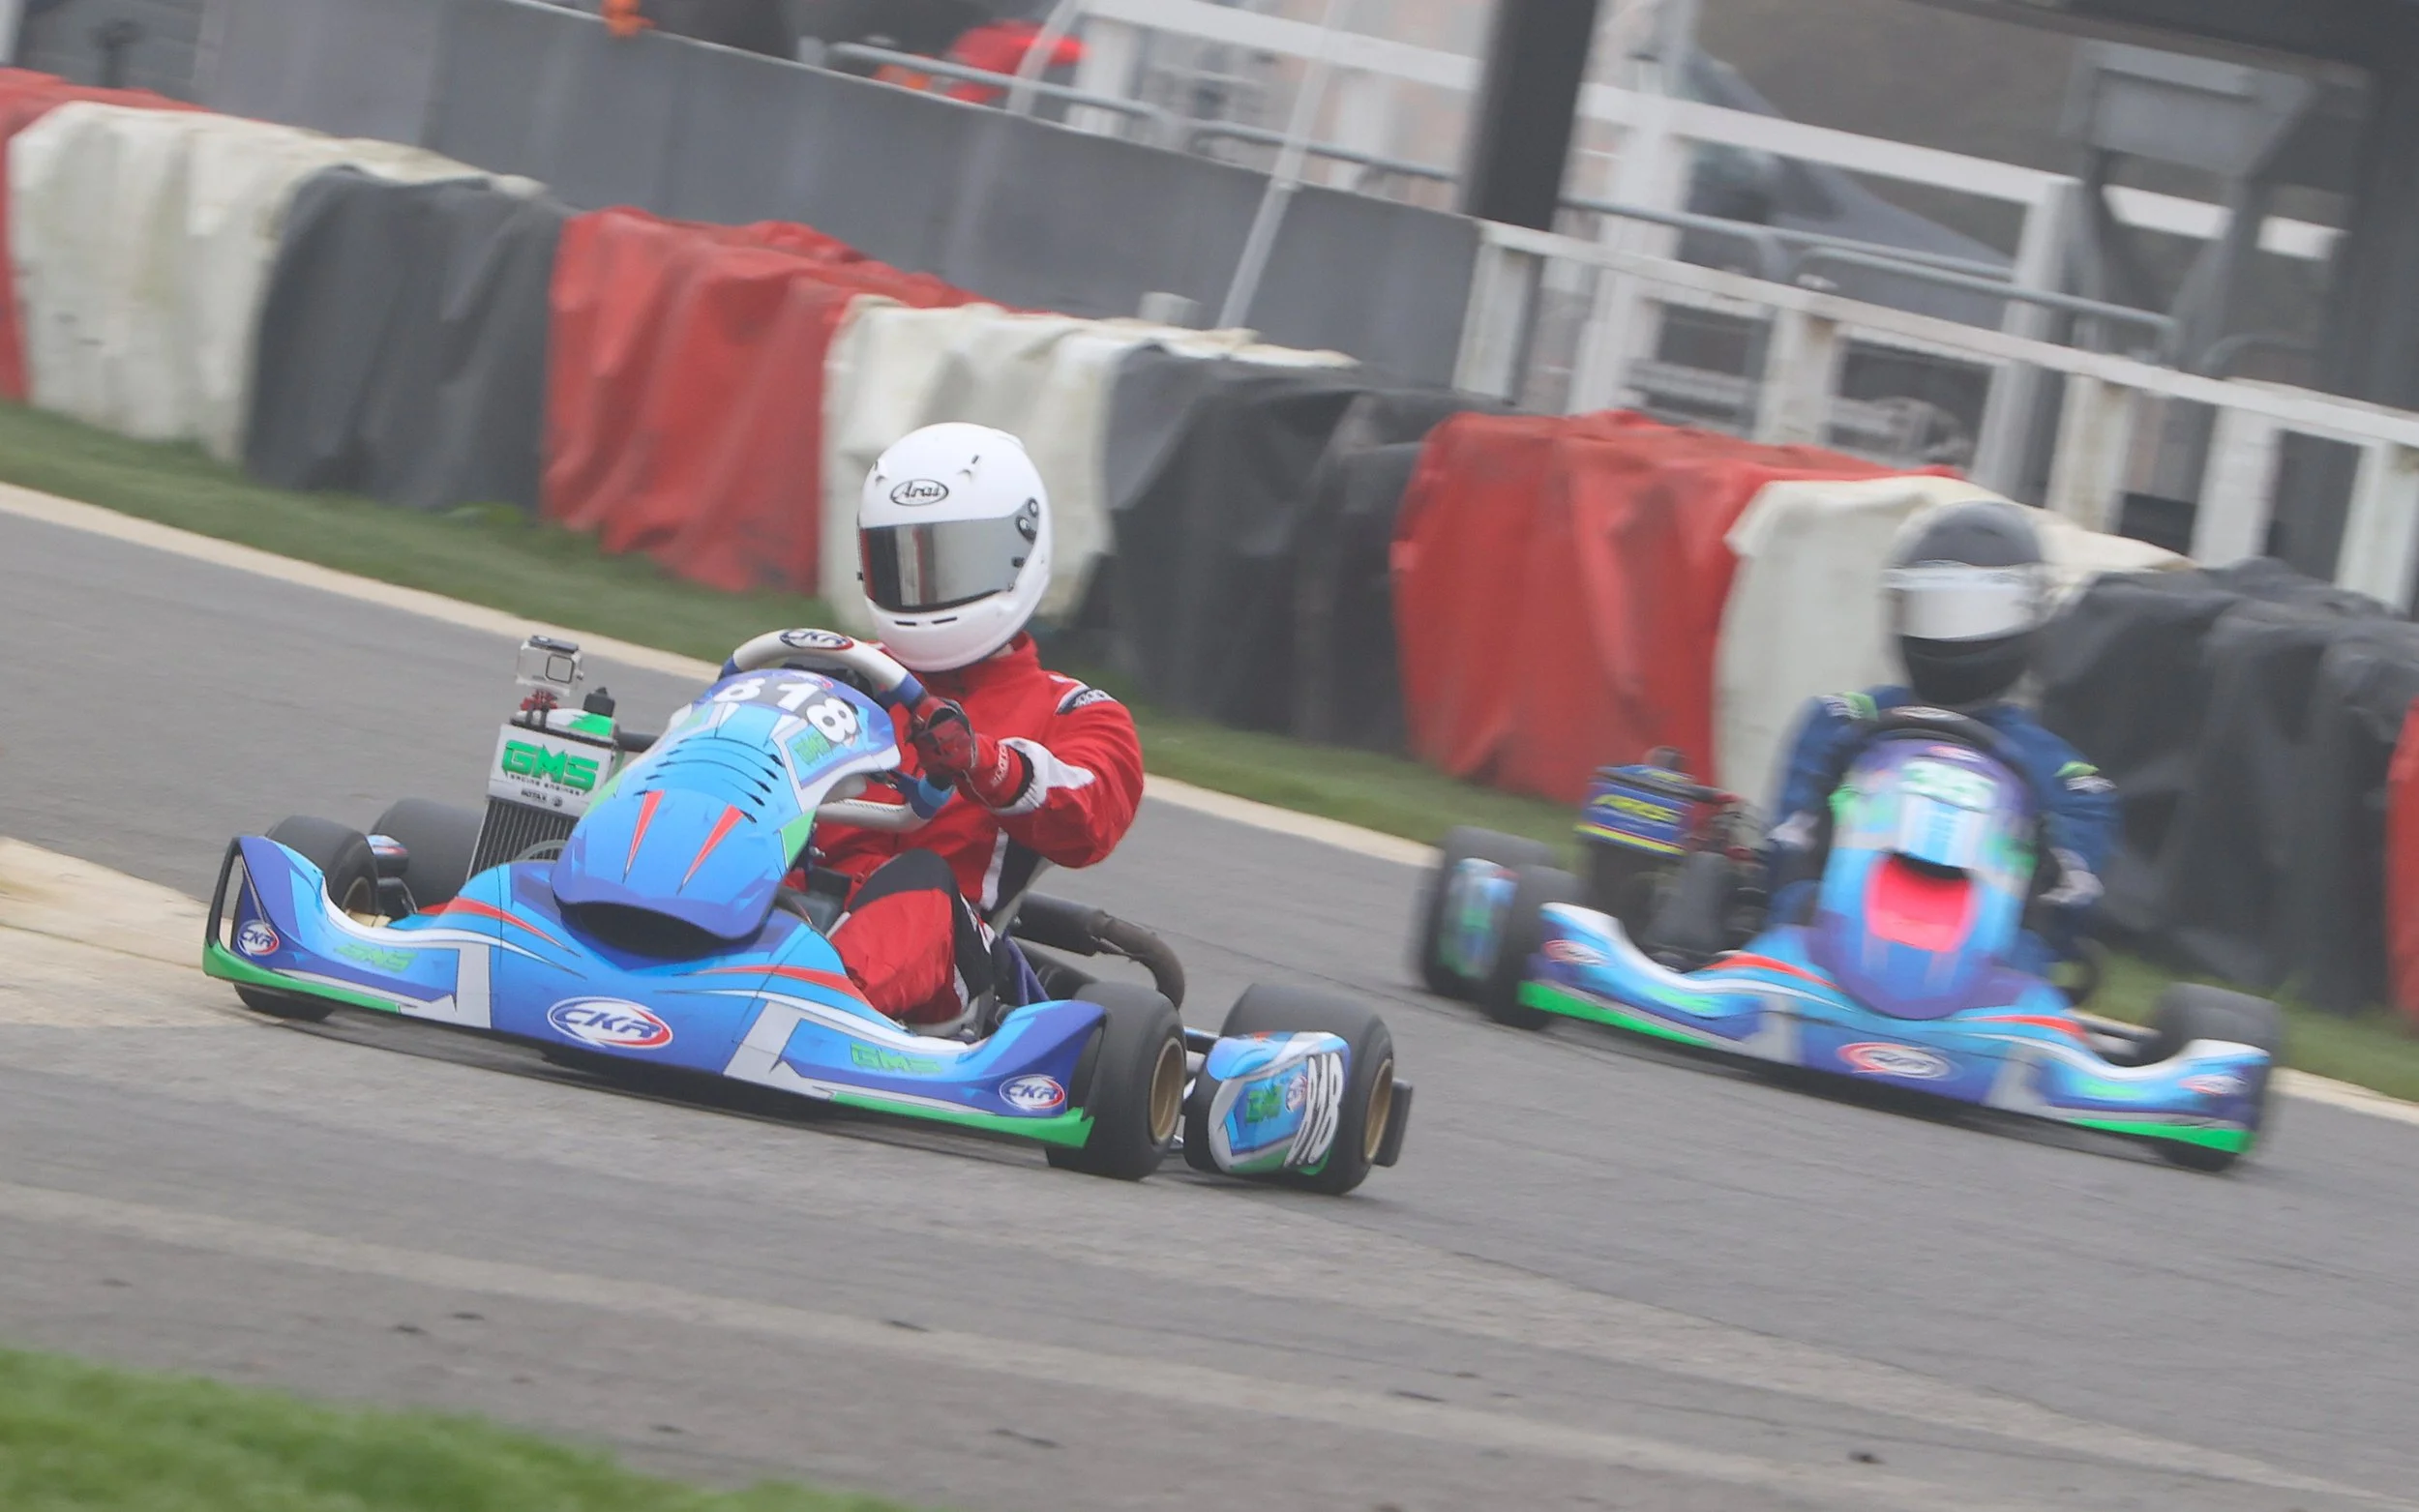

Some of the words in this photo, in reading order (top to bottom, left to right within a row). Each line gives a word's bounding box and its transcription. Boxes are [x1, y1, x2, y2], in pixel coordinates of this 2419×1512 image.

[900, 480, 941, 498] Arai
[501, 739, 600, 793] GMS
[240, 927, 276, 948] CKR
[552, 1006, 662, 1039] CKR
[1004, 1082, 1058, 1101] CKR
[1282, 1052, 1344, 1169] 818
